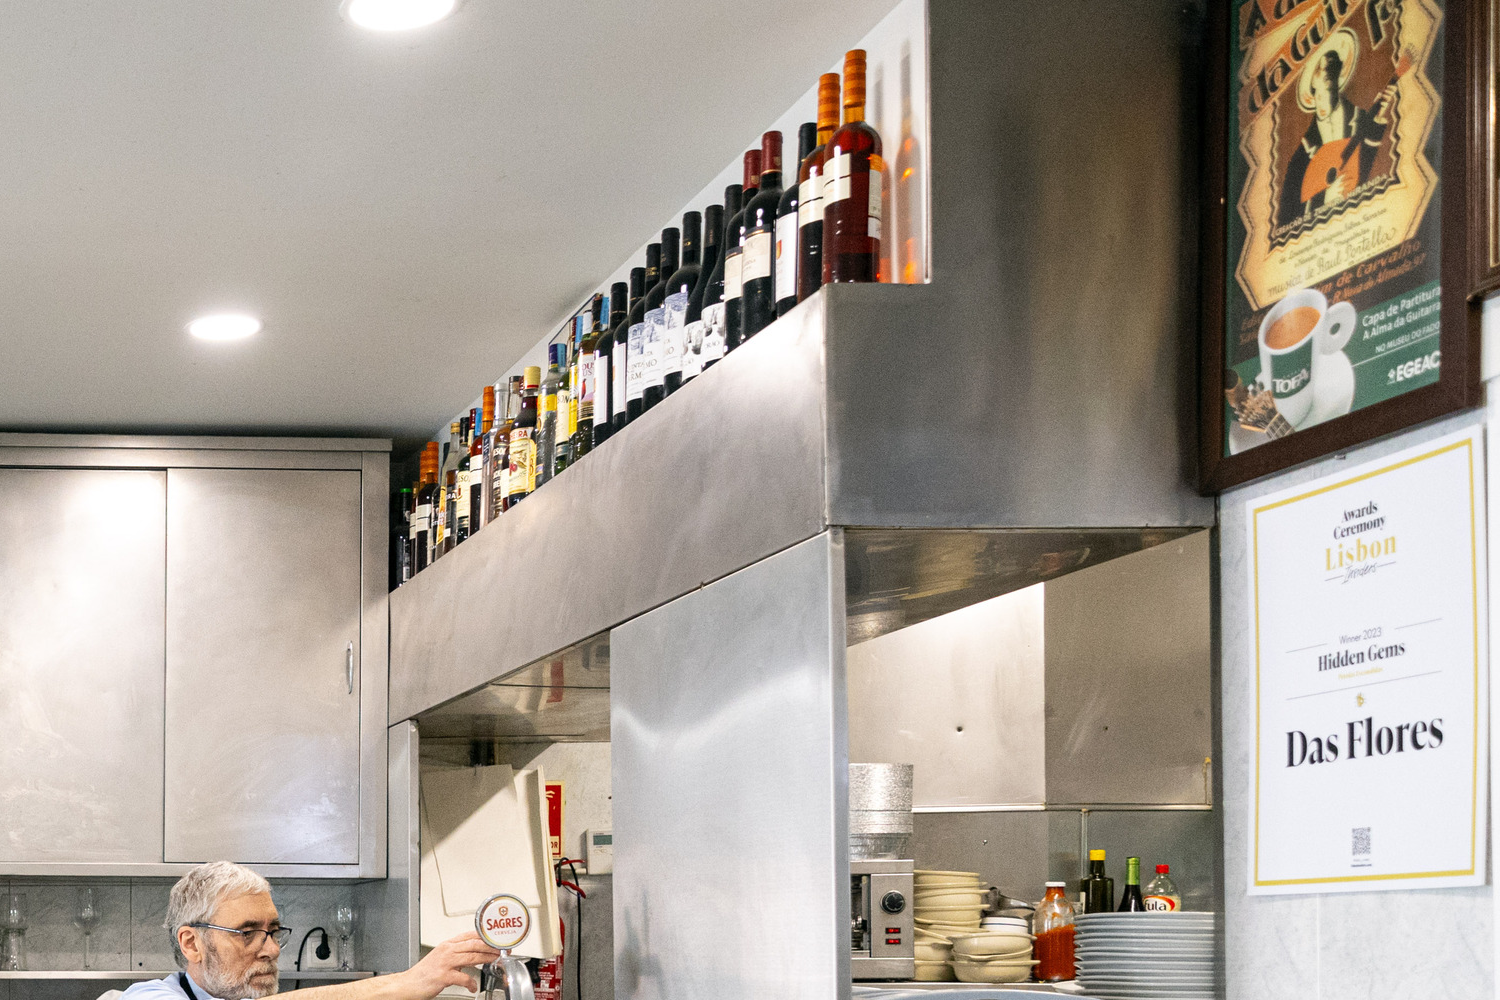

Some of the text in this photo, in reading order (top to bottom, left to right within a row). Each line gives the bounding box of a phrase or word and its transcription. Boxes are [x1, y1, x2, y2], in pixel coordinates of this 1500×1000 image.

[1362, 311, 1386, 329] Capa
[1387, 304, 1399, 316] de
[1370, 322, 1392, 340] Alma
[1393, 316, 1405, 329] da
[1396, 350, 1441, 383] EGEAC
[1342, 501, 1378, 522] Awards
[1334, 515, 1386, 540] Ceremony
[1325, 535, 1397, 571] Lisbon
[1339, 626, 1382, 643] Winner 2023
[1318, 642, 1406, 672] Hidden Gems
[1285, 716, 1445, 768] Das Flores
[486, 916, 523, 931] SAGRES
